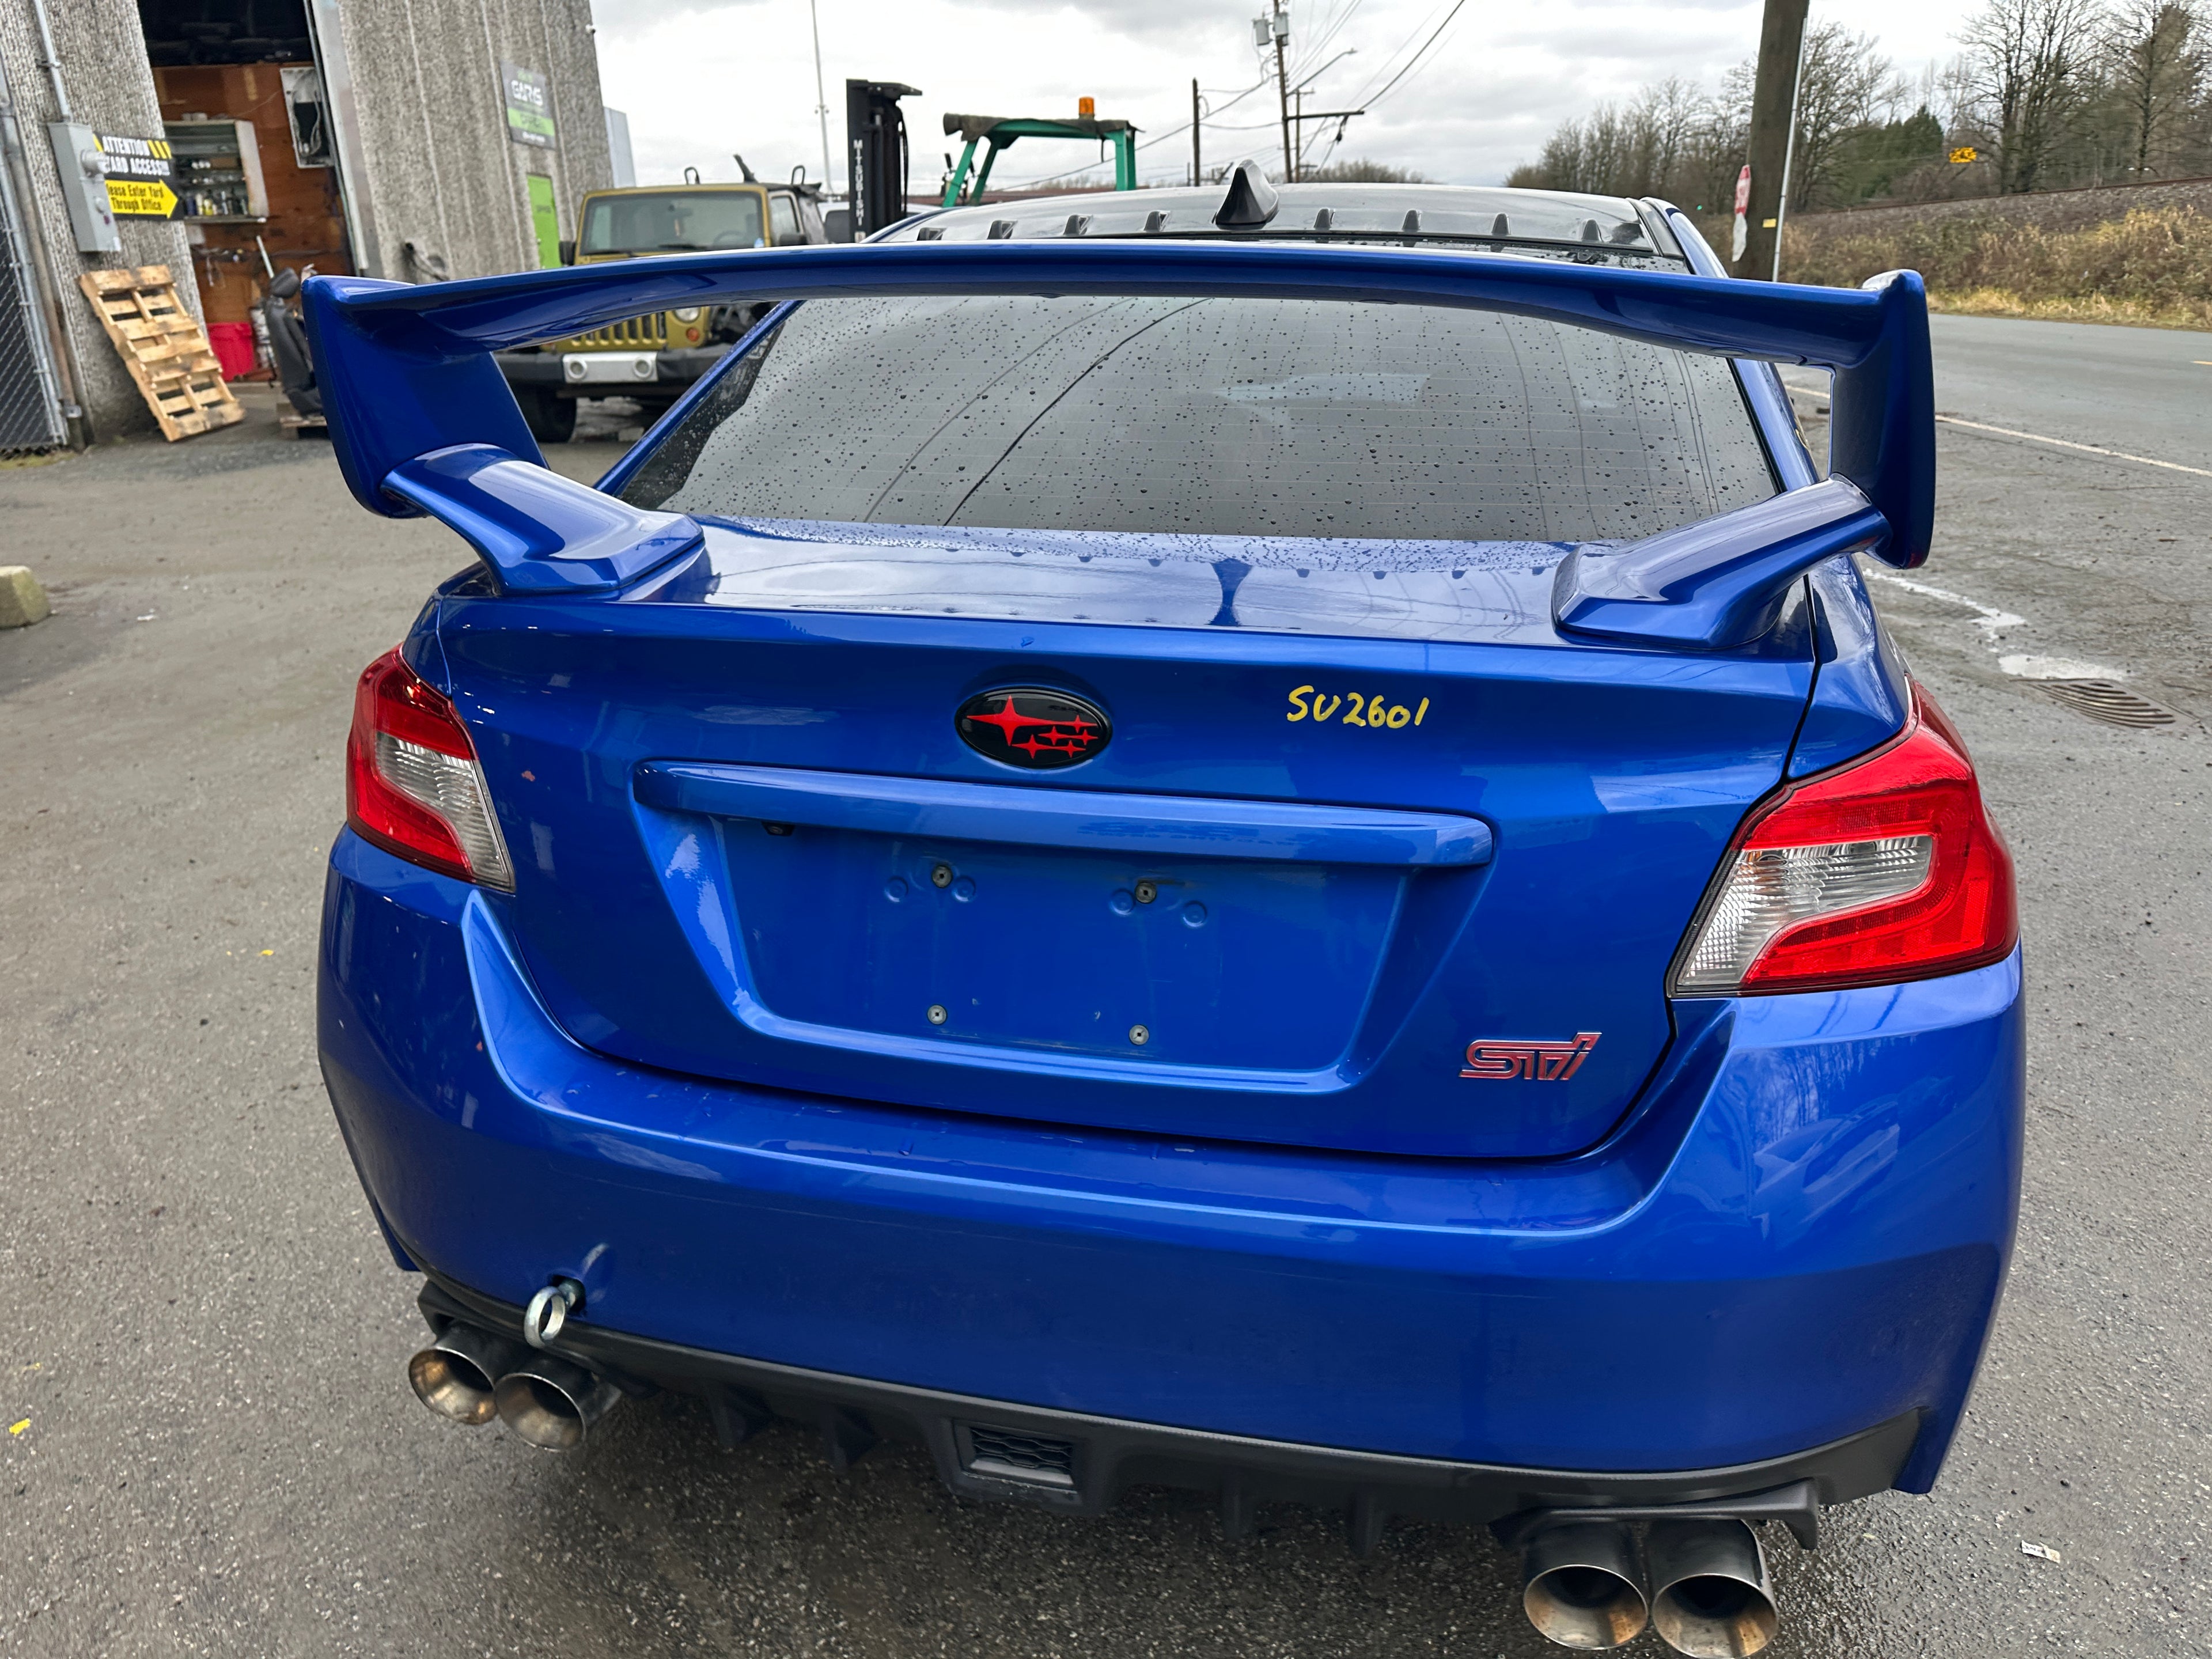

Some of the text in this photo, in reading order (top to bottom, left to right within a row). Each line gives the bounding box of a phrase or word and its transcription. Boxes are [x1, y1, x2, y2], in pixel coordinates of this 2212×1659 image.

[103, 136, 150, 156] ATTENTION
[109, 156, 128, 173] ARD
[106, 183, 164, 198] lease Enter Yard
[853, 139, 864, 226] MITSUBISHI
[111, 197, 162, 212] Through Office
